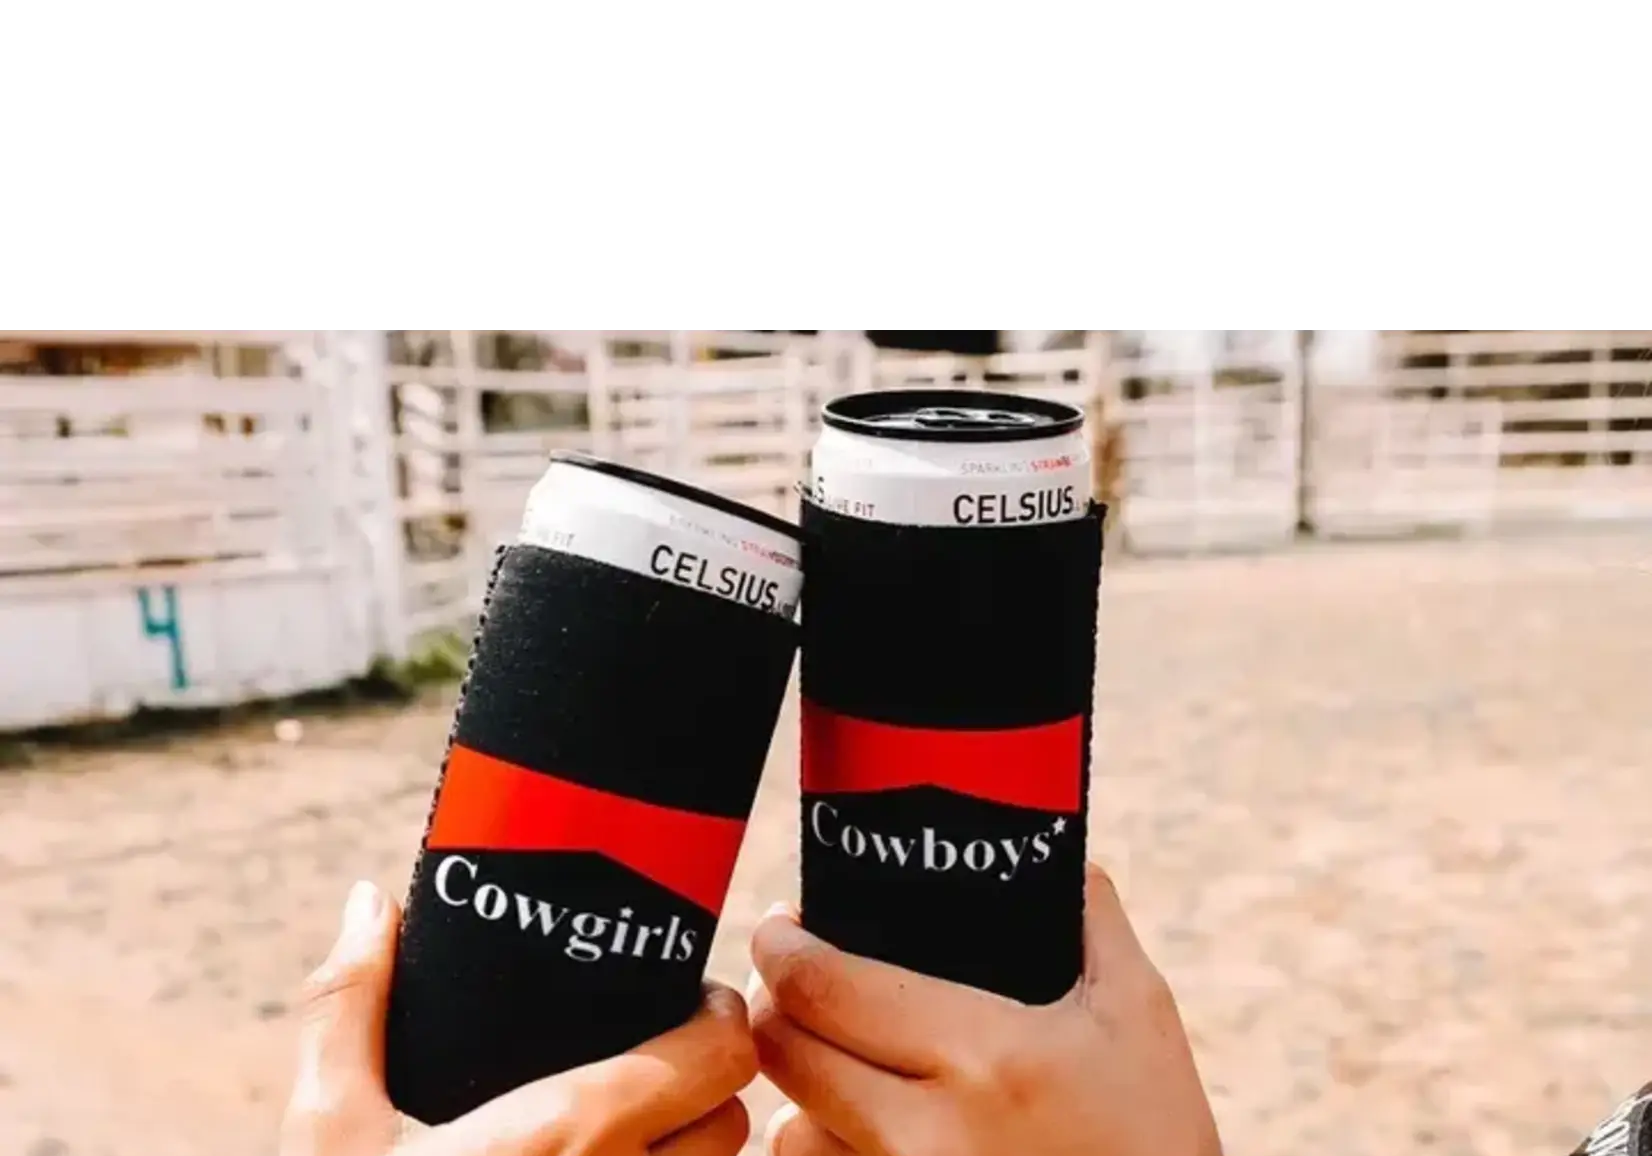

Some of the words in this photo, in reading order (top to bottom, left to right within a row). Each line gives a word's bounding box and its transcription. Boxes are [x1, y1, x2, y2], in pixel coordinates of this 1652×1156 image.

[953, 485, 1075, 524] CELSIUS
[650, 544, 779, 610] CELSIUS
[137, 586, 187, 690] 4
[811, 800, 1052, 881] Cowboys
[434, 854, 698, 962] Cowgirls
